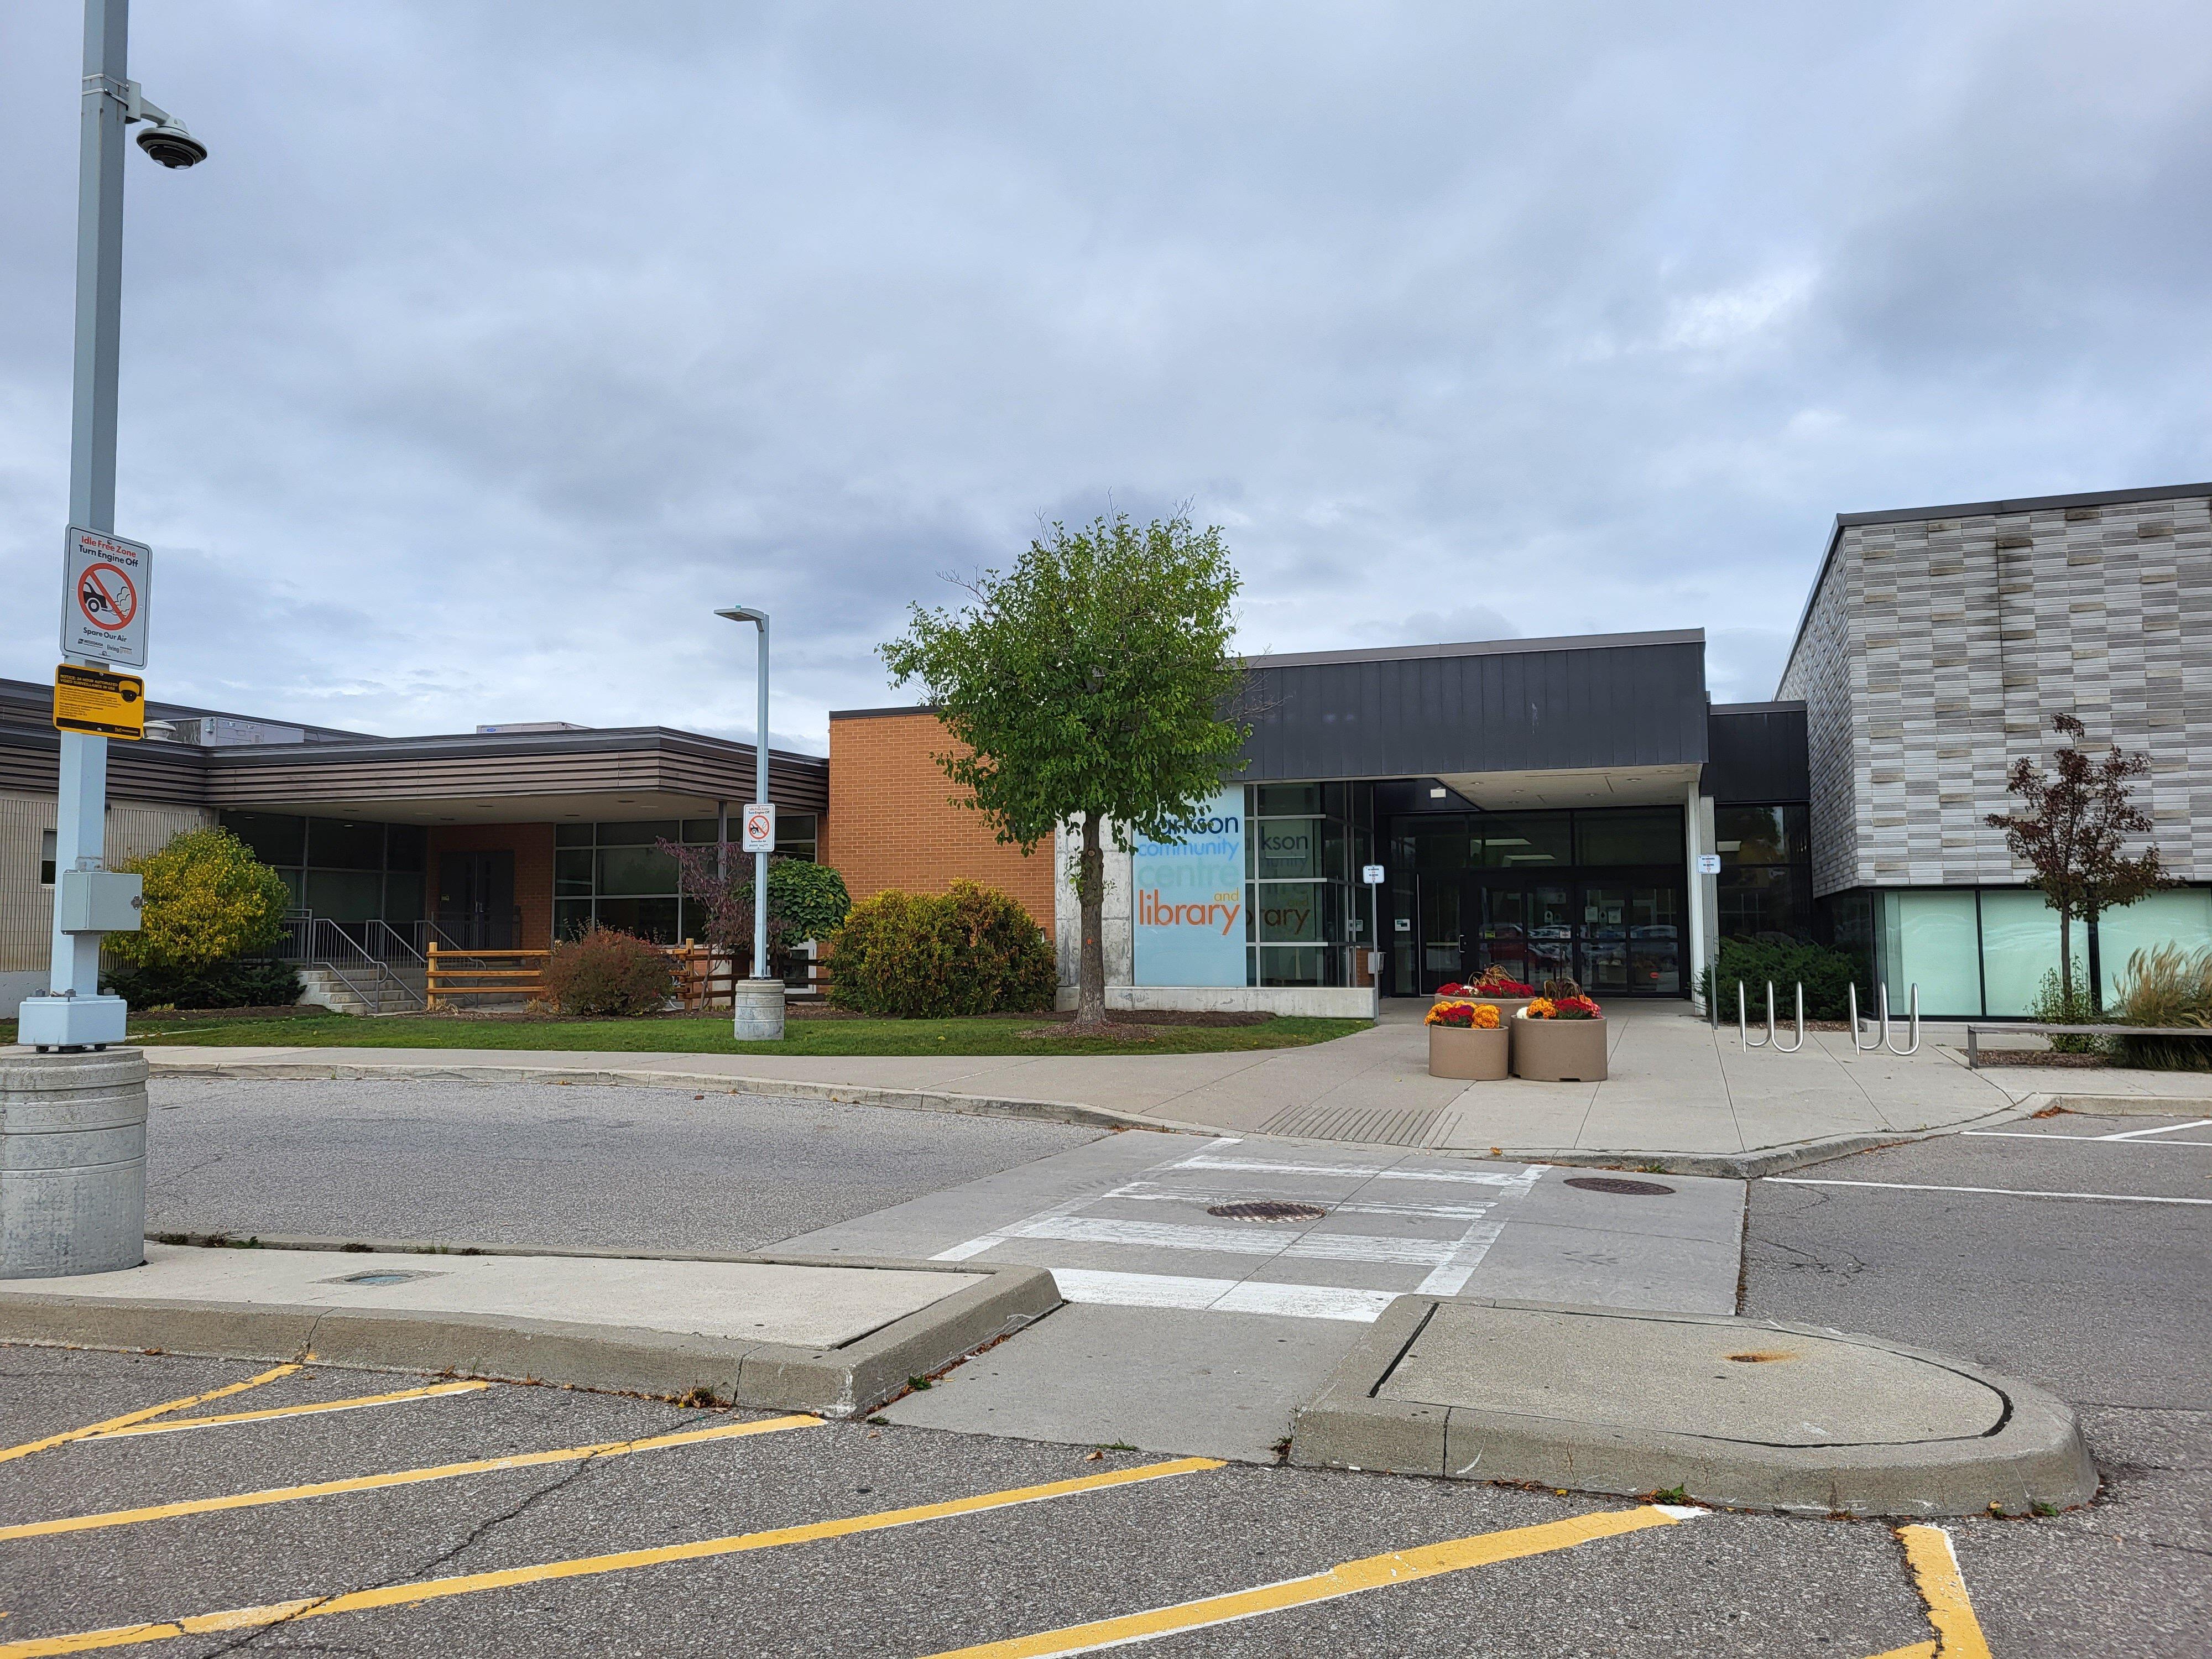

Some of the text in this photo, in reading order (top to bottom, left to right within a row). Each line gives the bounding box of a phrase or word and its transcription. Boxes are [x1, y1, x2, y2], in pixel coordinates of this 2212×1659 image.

[79, 544, 139, 567] Turn Engine Off
[81, 535, 137, 557] Idle Free Zone
[83, 627, 103, 637] Spare
[103, 632, 117, 640] Our
[1138, 836, 1239, 860] community
[1138, 858, 1239, 887] centre
[1214, 887, 1239, 901] and
[1139, 889, 1241, 935] library
